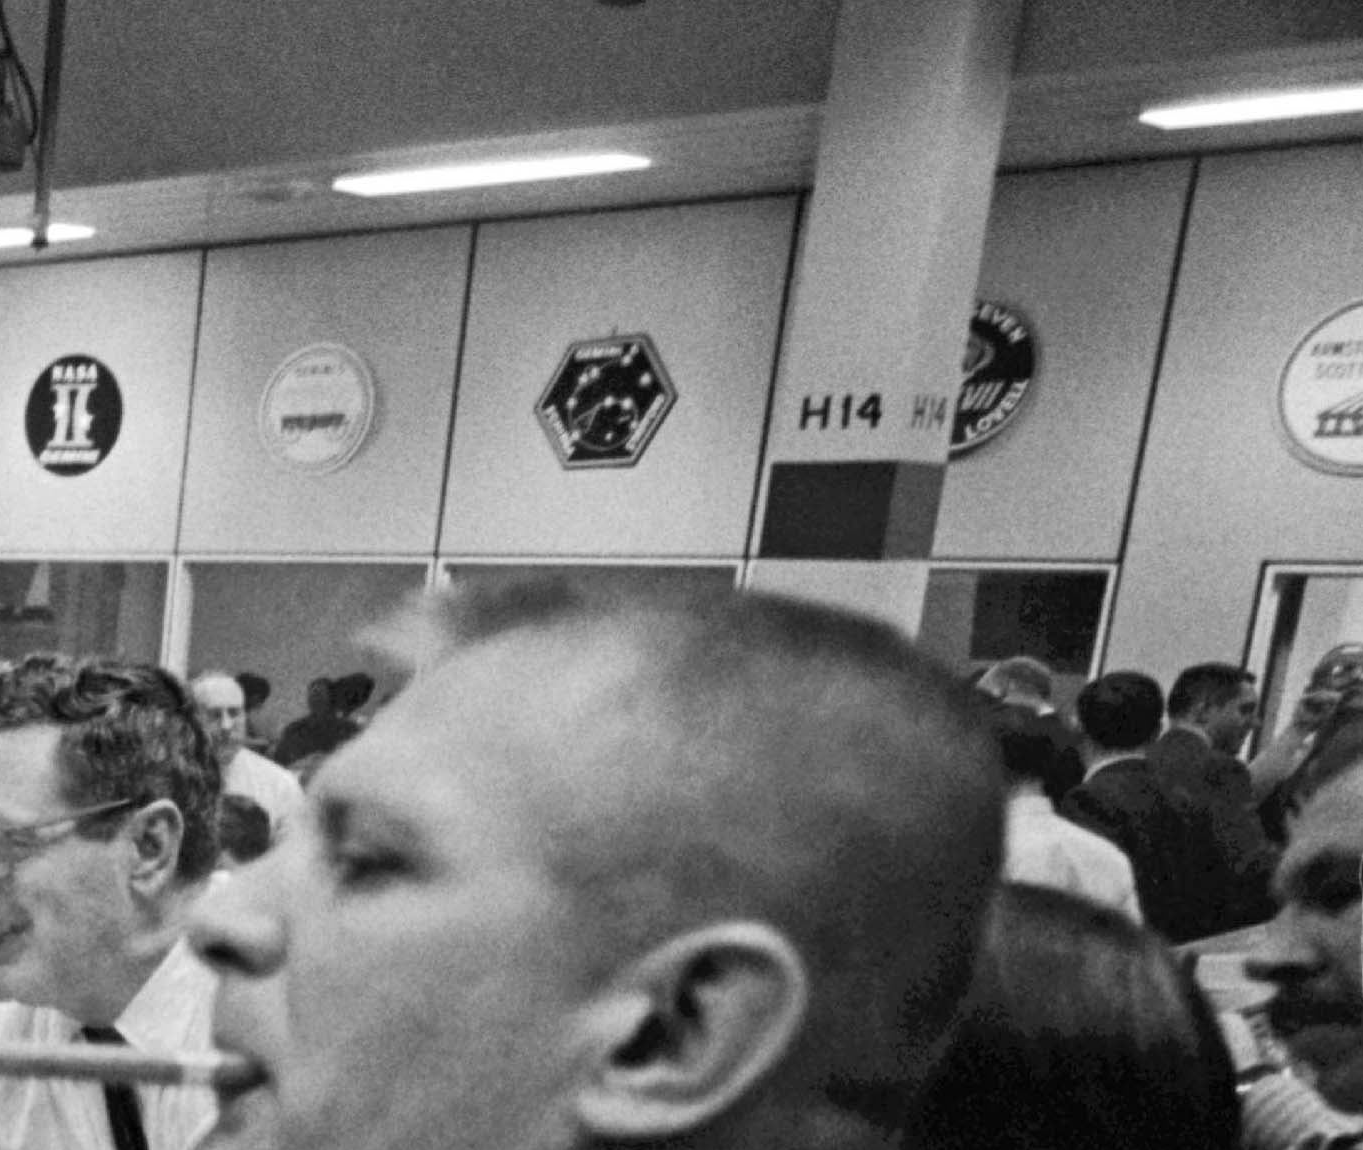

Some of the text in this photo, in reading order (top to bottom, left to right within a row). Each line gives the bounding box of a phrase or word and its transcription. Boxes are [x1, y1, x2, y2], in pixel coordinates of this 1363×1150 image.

[52, 364, 98, 381] NASA
[798, 393, 883, 431] H14
[910, 396, 949, 430] H14
